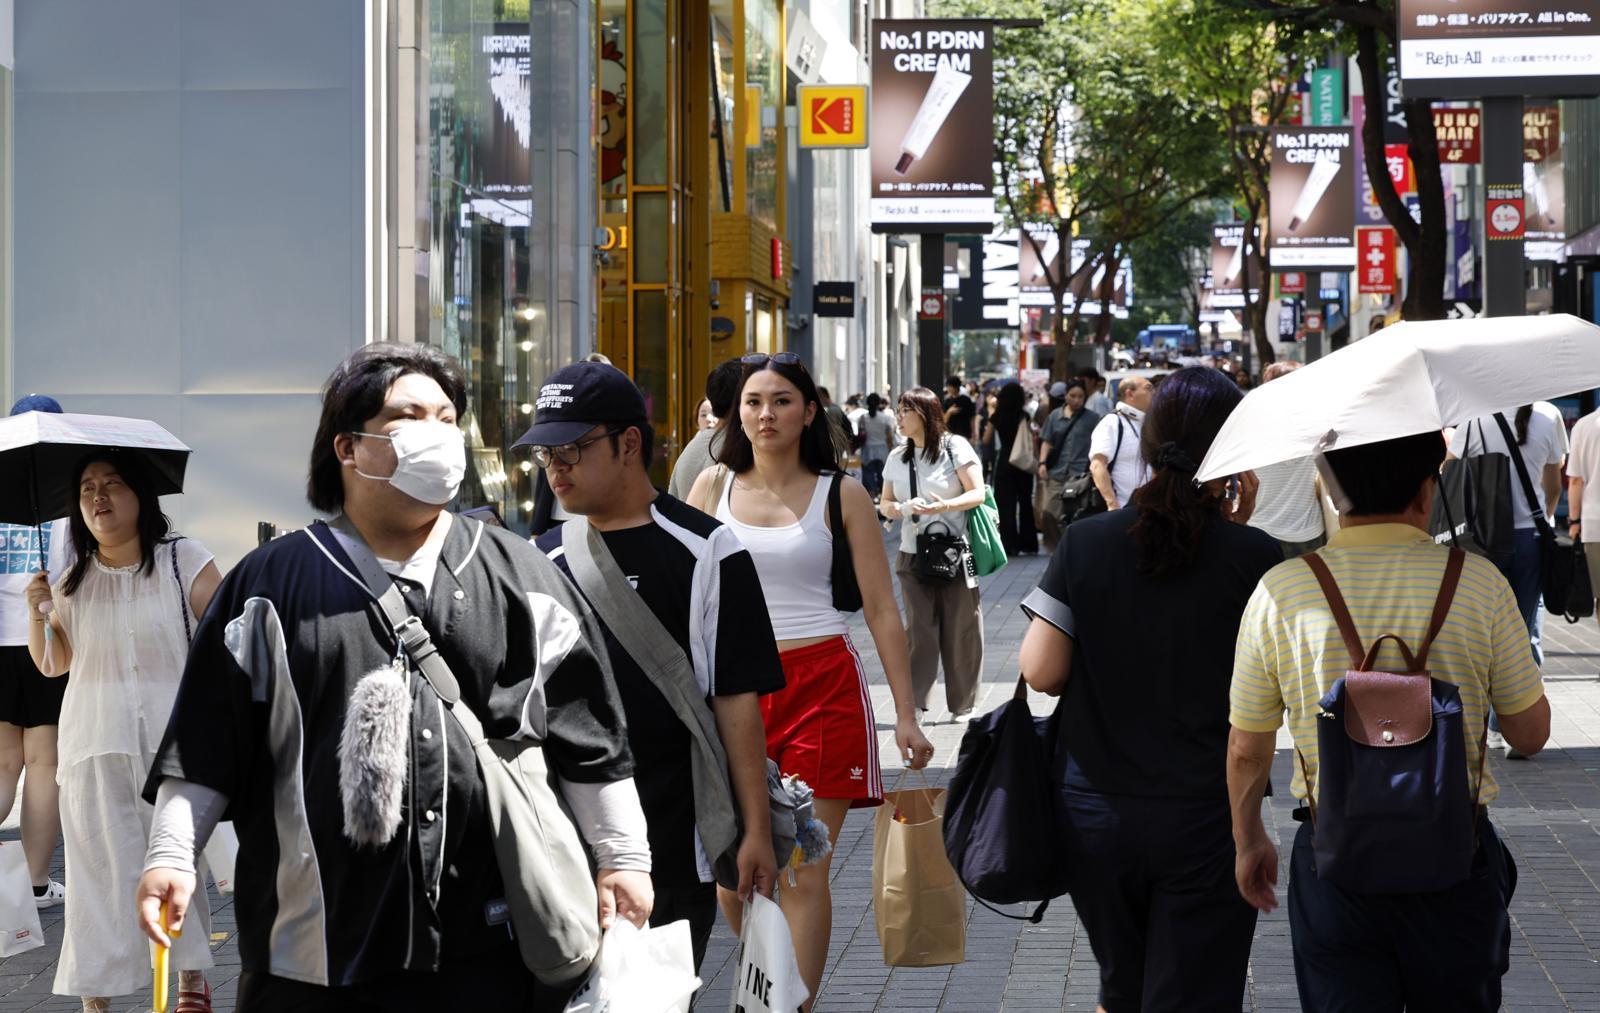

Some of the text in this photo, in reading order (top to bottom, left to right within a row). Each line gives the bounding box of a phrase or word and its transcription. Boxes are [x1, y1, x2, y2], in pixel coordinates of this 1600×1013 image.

[880, 31, 985, 50] No.1 PDRN
[894, 53, 971, 72] CREAM
[1319, 74, 1334, 126] NATUR
[1433, 112, 1479, 127] JUNO
[1277, 133, 1350, 148] No.1 PDRN
[1436, 127, 1474, 140] HAIR
[1285, 149, 1341, 163] CREAM
